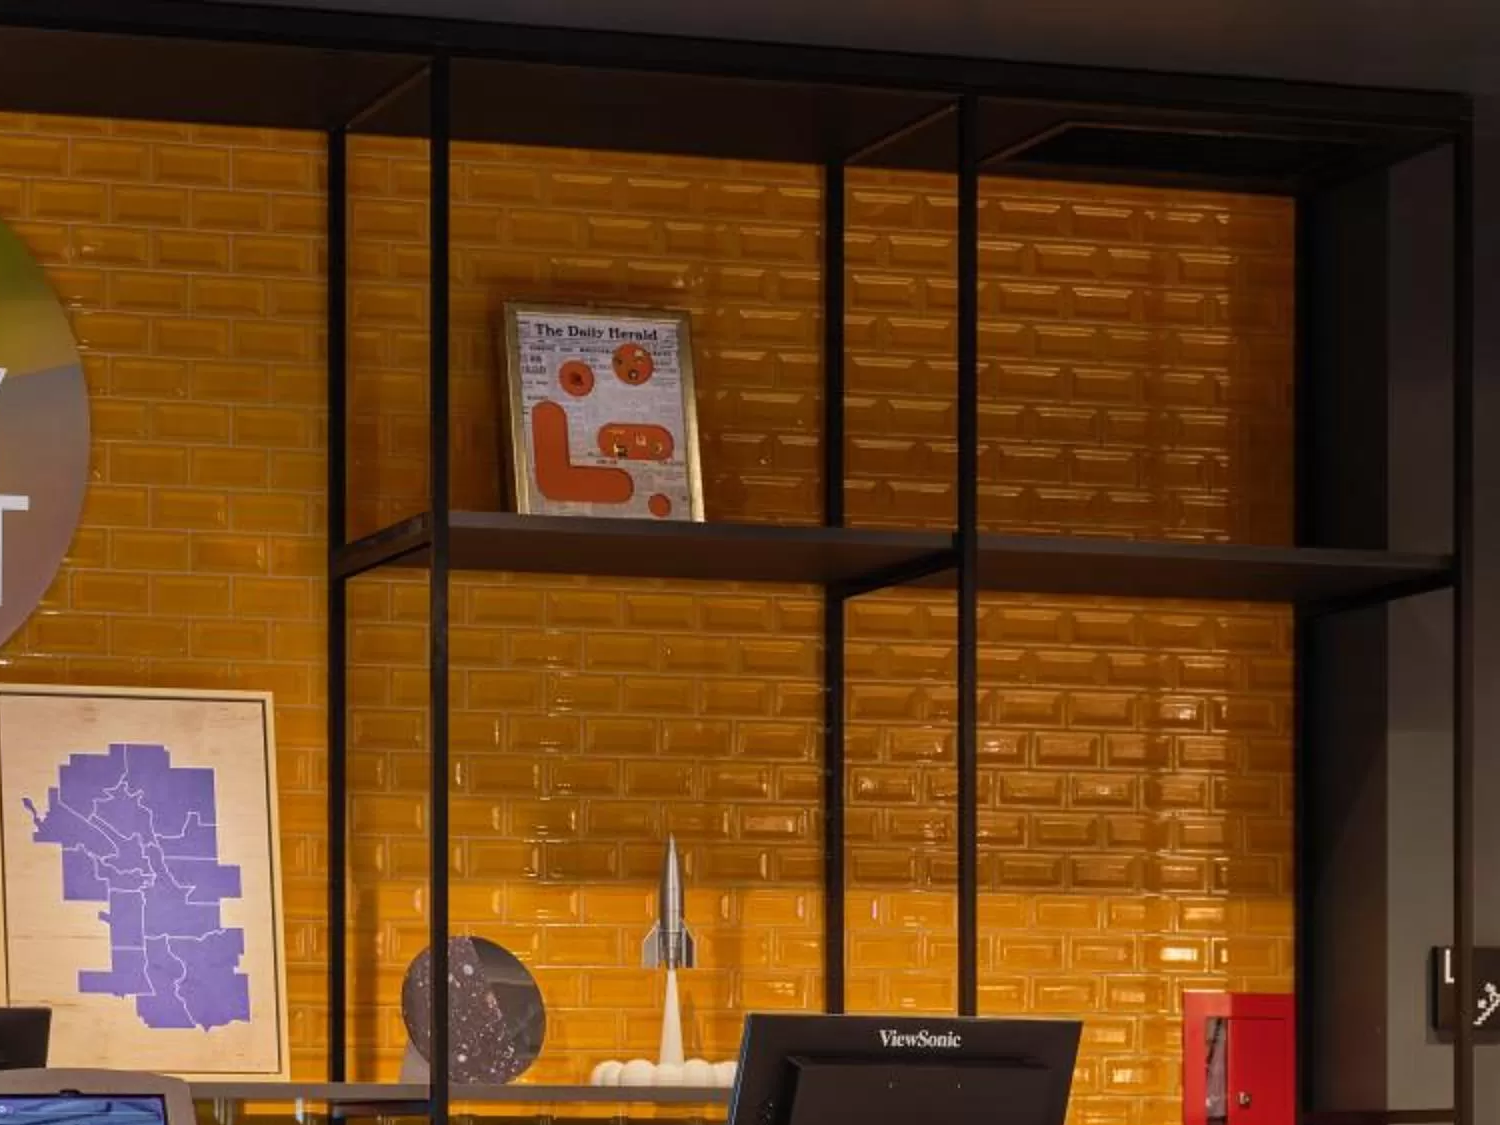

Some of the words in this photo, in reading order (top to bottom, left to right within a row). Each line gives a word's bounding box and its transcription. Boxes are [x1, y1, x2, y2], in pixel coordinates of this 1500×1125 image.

[534, 323, 564, 338] The
[567, 325, 605, 340] Daily
[608, 327, 658, 342] Herald
[879, 1028, 962, 1049] ViewSonic
